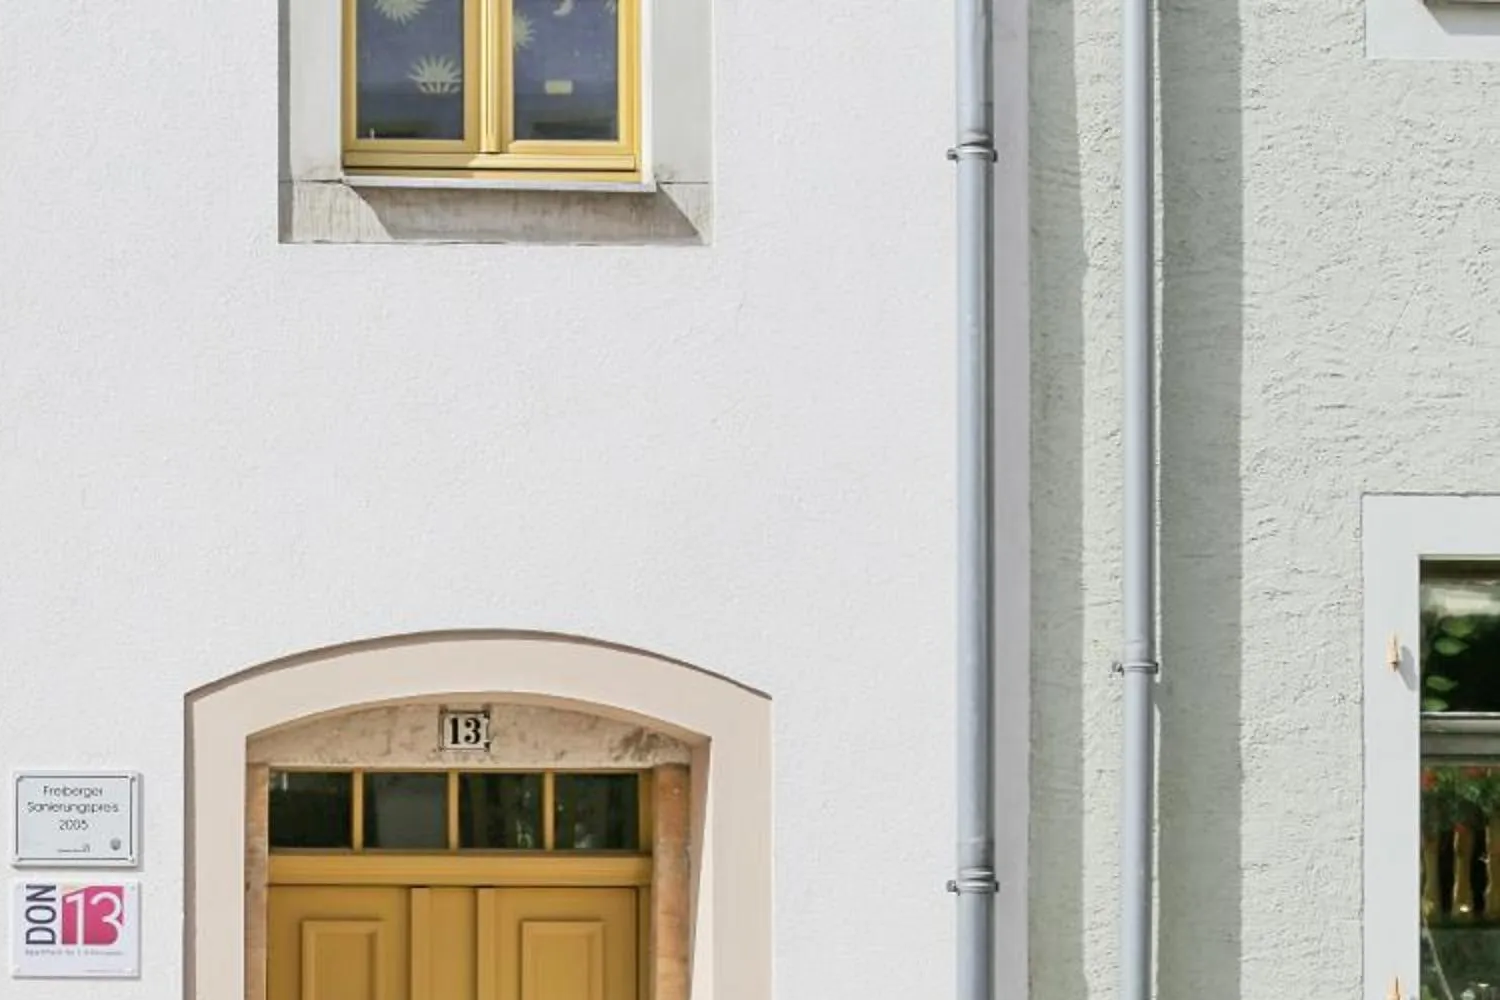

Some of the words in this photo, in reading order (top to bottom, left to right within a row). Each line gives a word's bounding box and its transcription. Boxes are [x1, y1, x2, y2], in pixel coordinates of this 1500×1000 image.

[451, 716, 481, 745] 13
[43, 785, 104, 799] Freiberger
[25, 884, 57, 945] DON
[61, 885, 125, 946] 13
